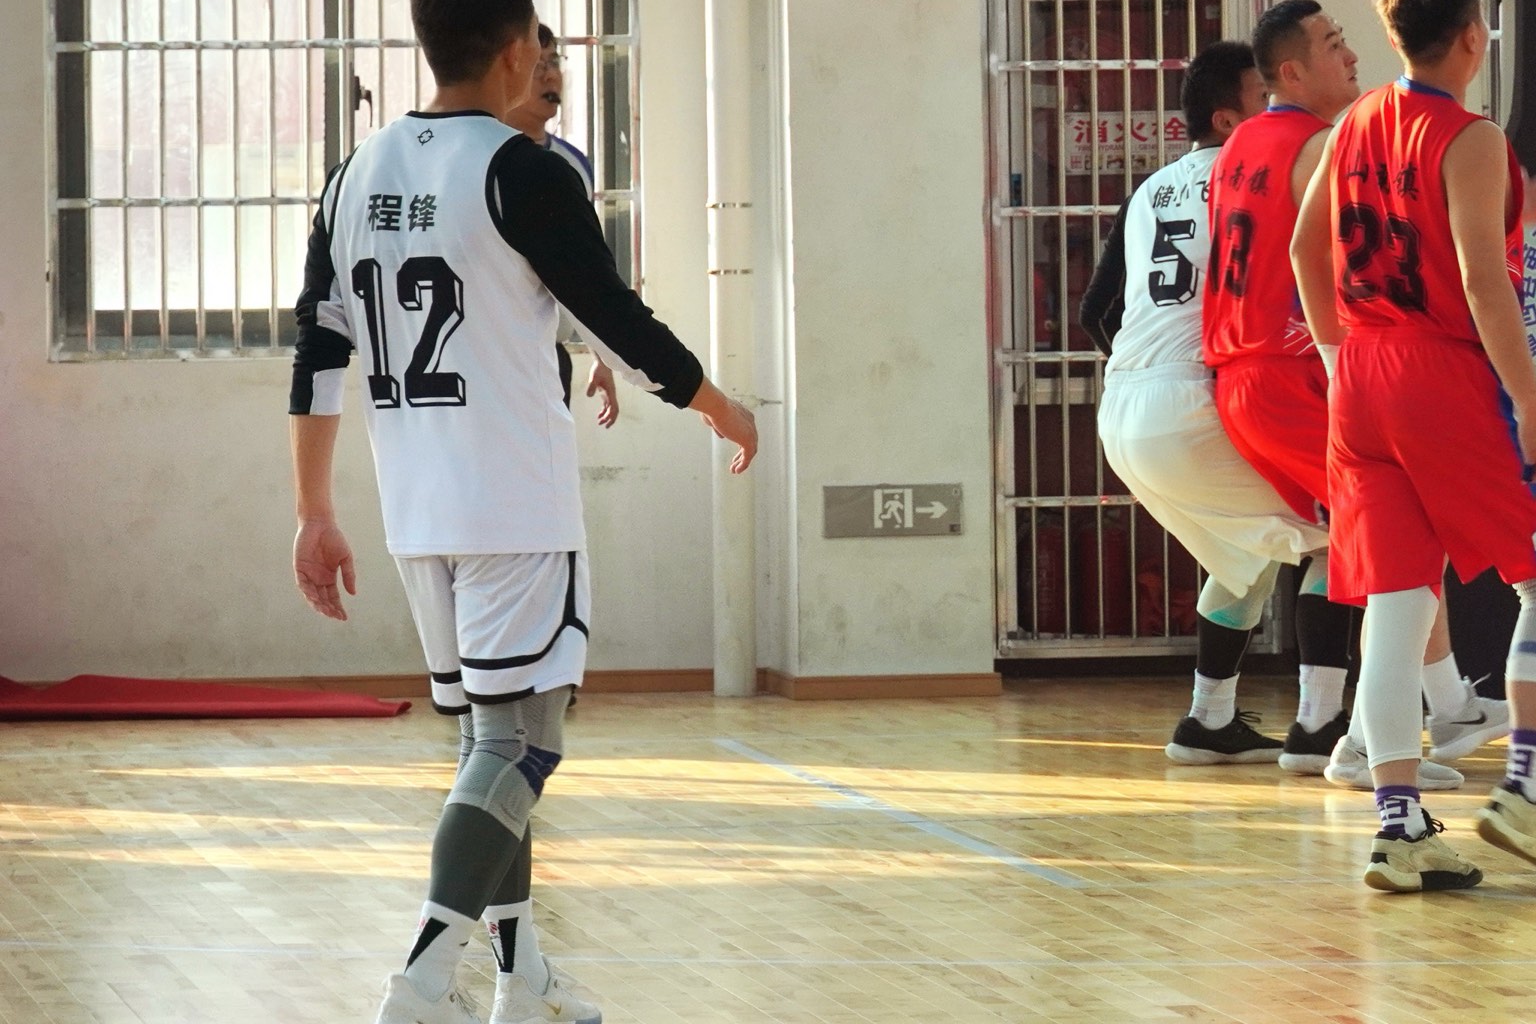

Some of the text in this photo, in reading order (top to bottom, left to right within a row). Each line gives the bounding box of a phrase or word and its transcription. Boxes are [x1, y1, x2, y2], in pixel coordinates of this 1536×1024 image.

[1073, 117, 1188, 143] 消火栓
[368, 194, 437, 232] 程锋
[1209, 206, 1255, 299] 13
[1338, 202, 1428, 313] 23
[1148, 216, 1199, 307] 5
[352, 256, 466, 409] 12
